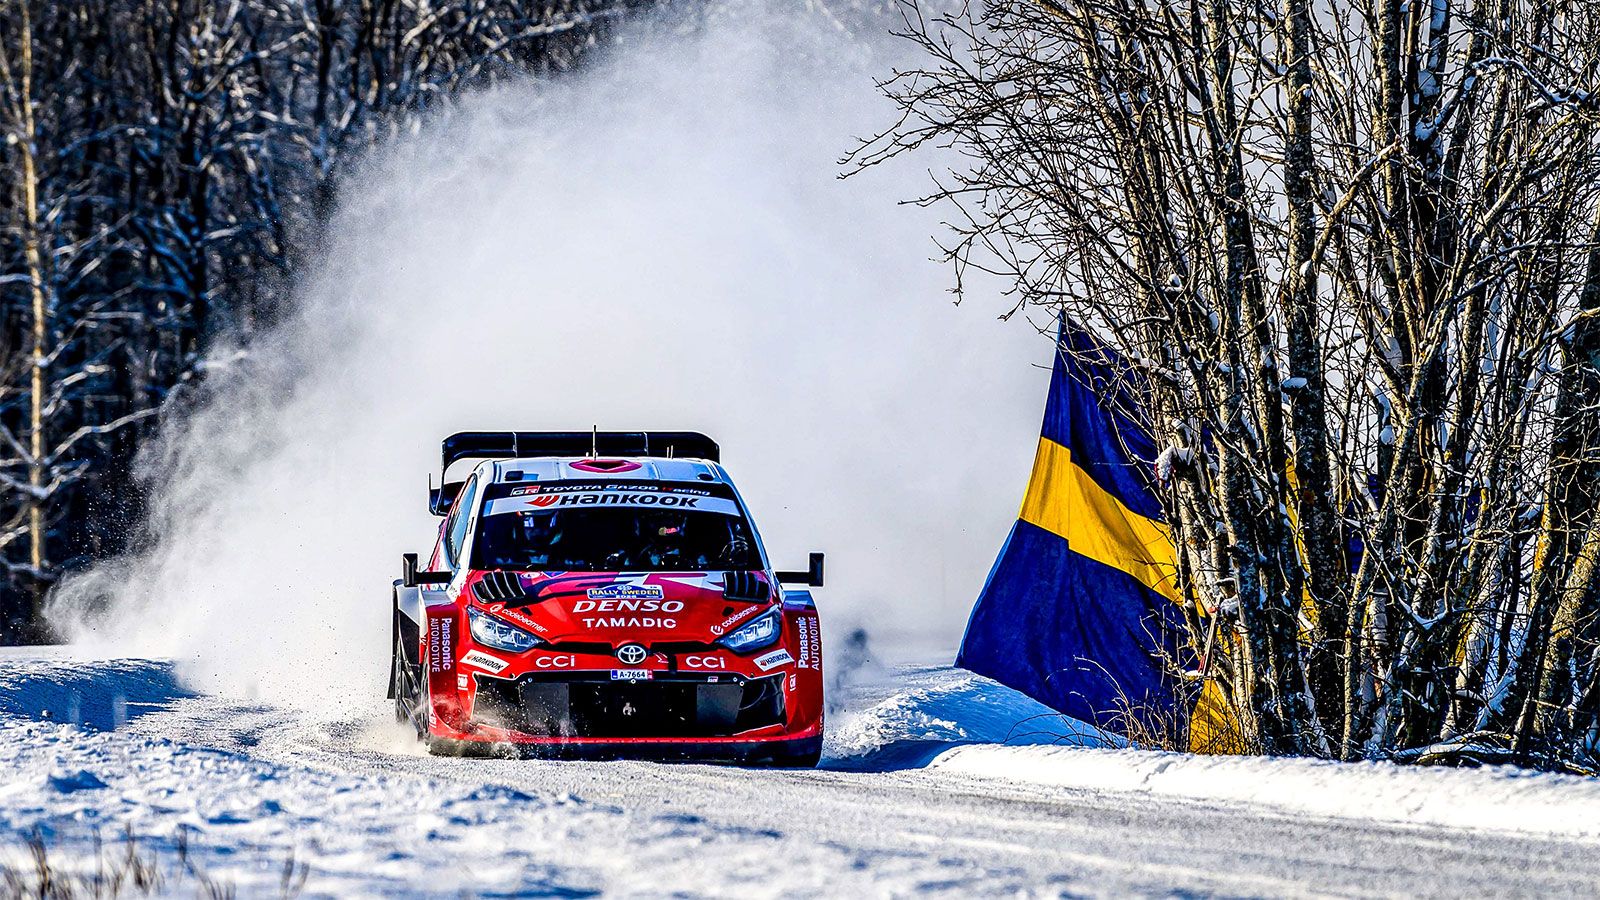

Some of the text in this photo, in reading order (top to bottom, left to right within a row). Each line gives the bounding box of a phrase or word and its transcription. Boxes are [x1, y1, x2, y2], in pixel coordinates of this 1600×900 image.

[543, 485, 602, 493] TOYOTA
[501, 608, 549, 633] codebeamer
[572, 600, 685, 613] DENSO
[582, 618, 677, 629] TAMADIC
[430, 617, 441, 673] AUTOMOTIVE
[441, 617, 454, 671] Panasonic
[795, 616, 809, 669] Panasonic
[807, 616, 820, 671] AUTOMOTIVE
